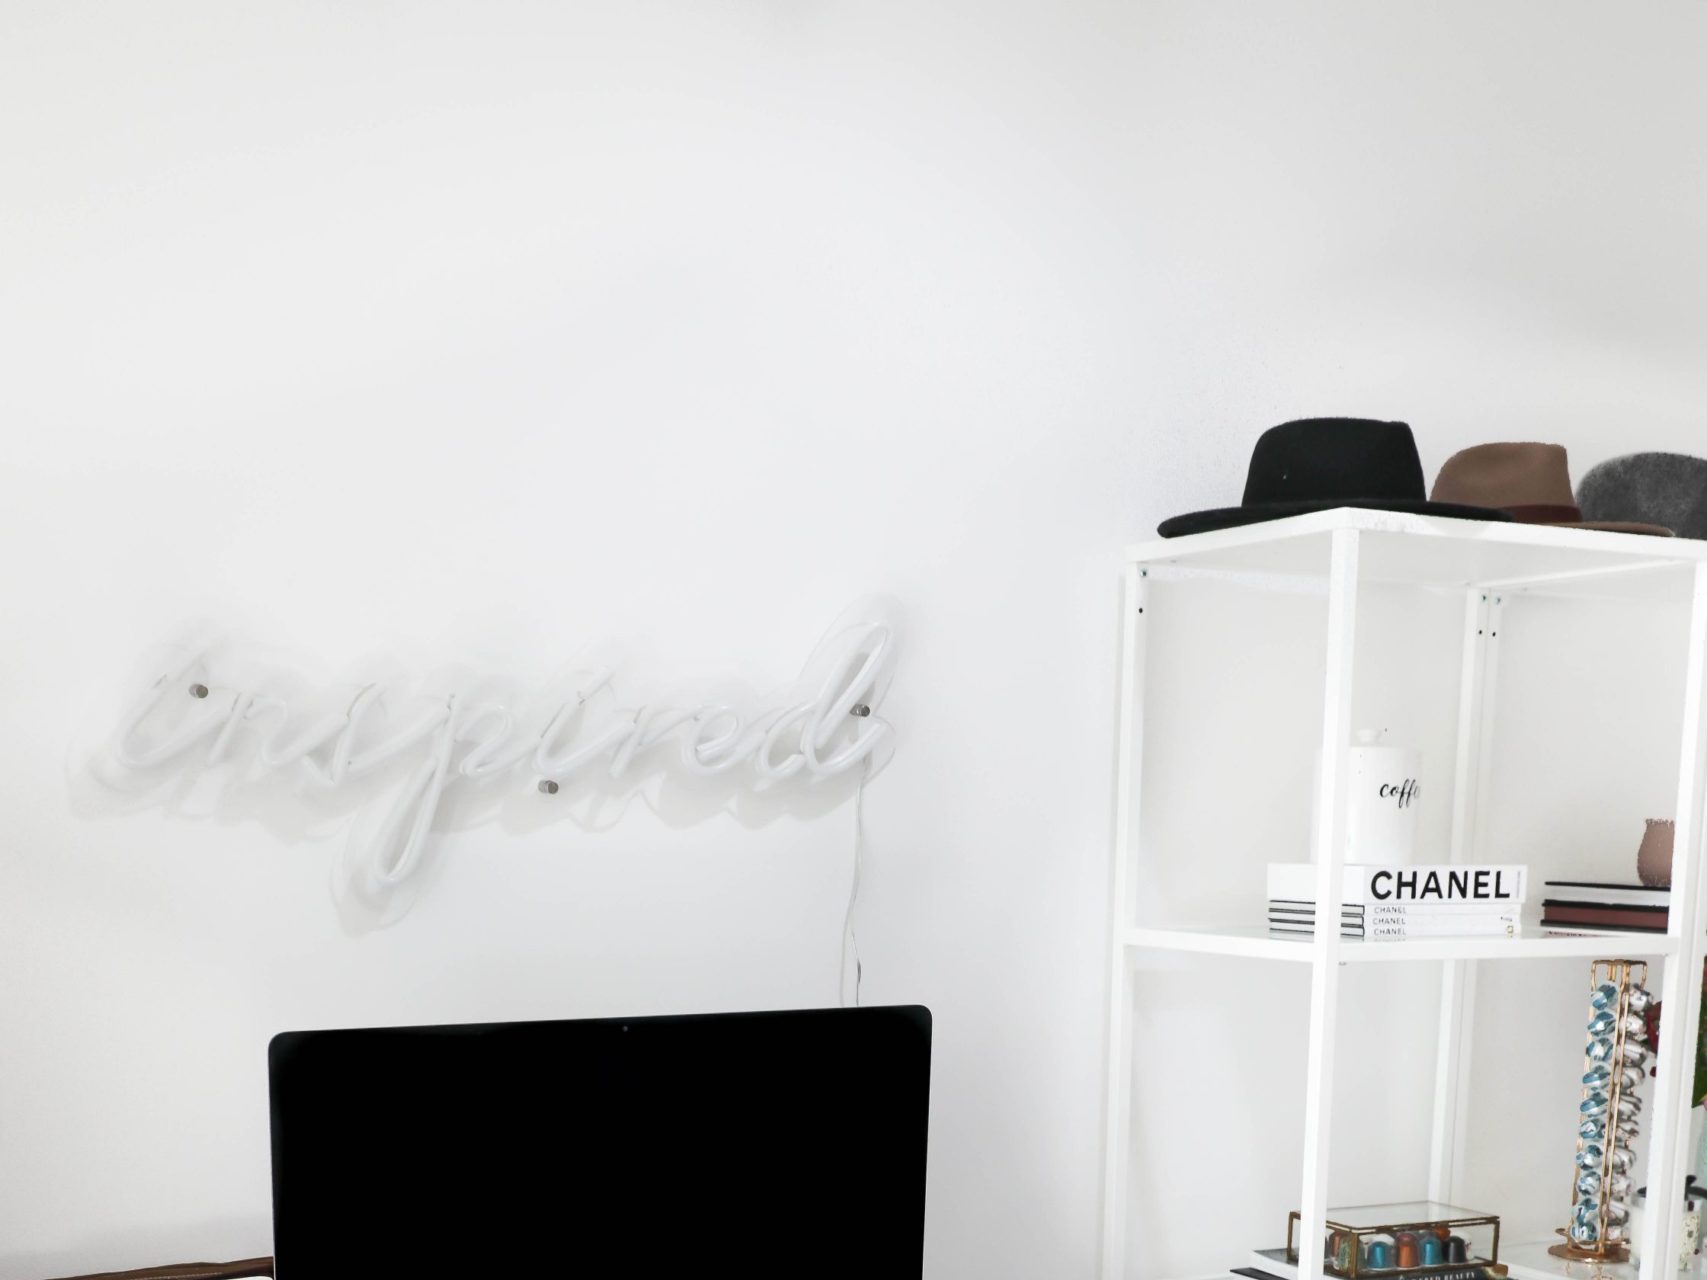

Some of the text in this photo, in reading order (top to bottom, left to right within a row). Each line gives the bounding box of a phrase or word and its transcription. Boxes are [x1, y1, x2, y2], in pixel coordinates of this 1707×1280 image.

[114, 620, 890, 888] inspired
[1370, 870, 1511, 900] CHANEL
[1373, 905, 1407, 914] CHANEL
[1372, 916, 1406, 925] CHANEL
[1373, 927, 1407, 936] CHANEL
